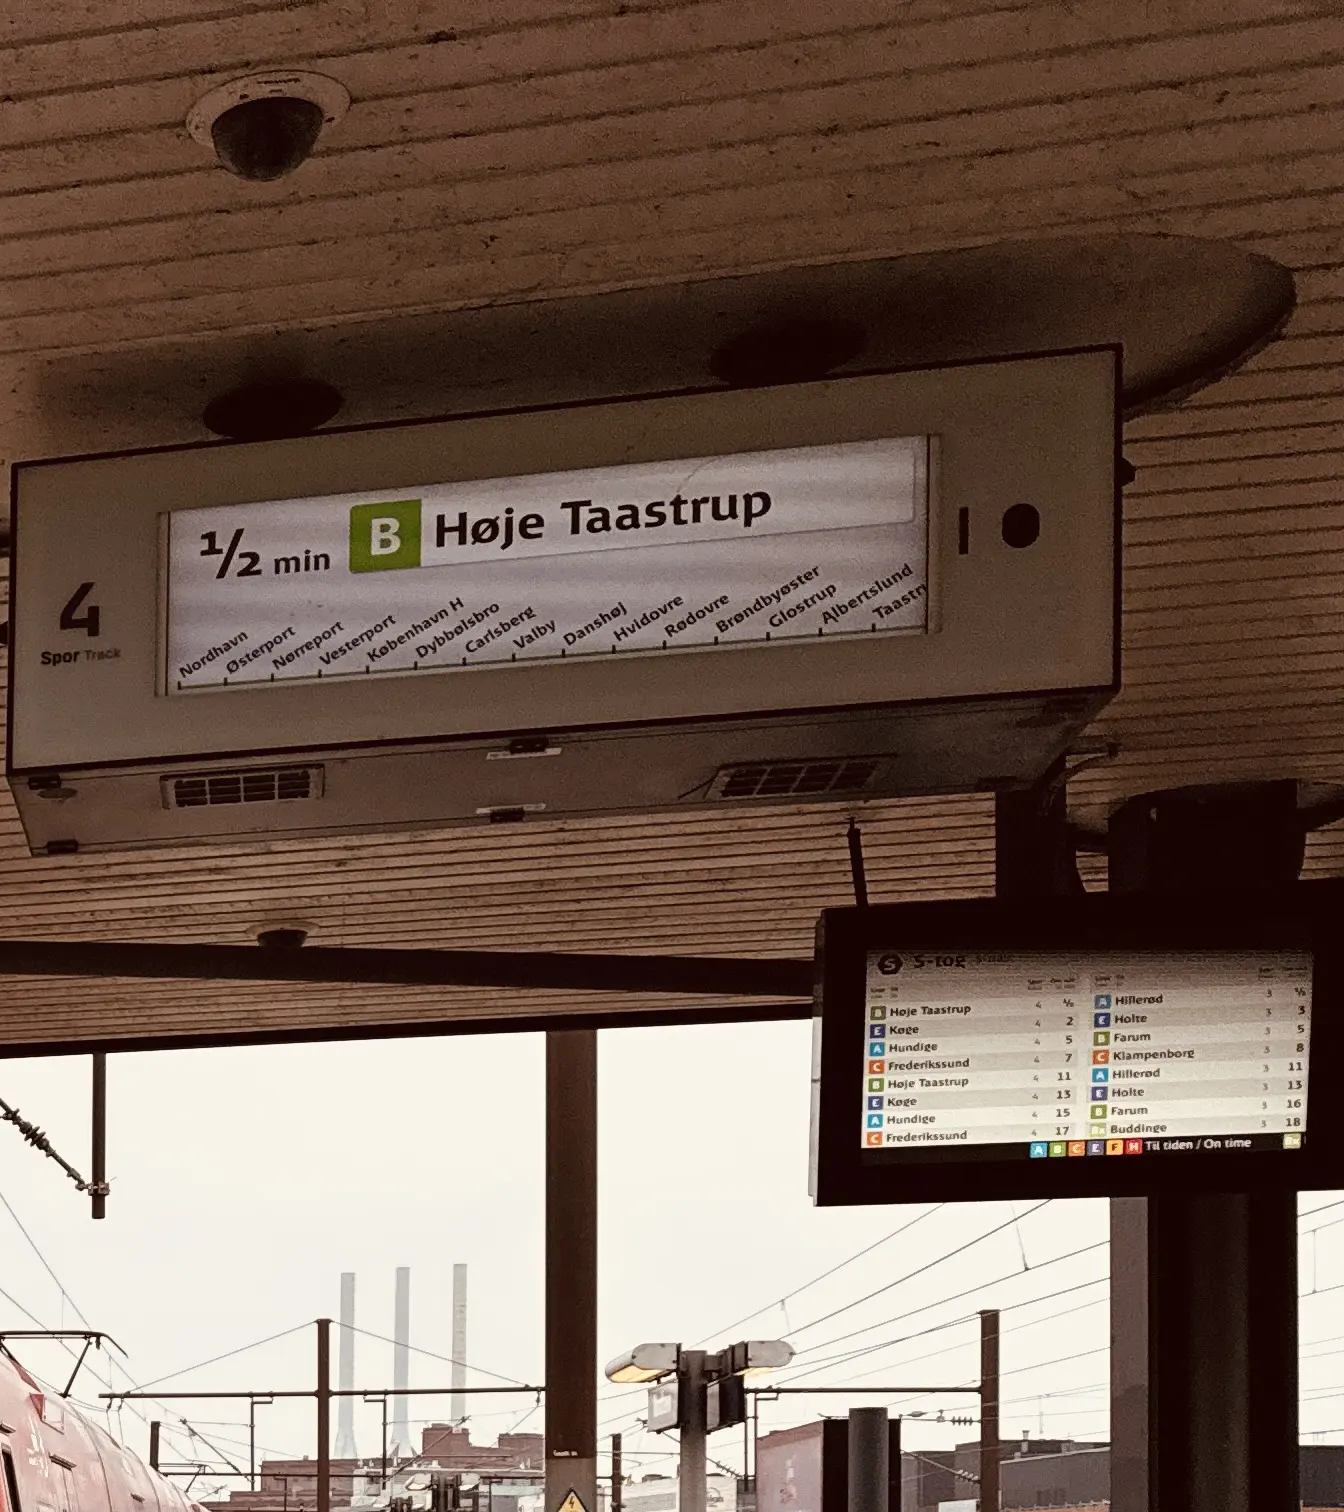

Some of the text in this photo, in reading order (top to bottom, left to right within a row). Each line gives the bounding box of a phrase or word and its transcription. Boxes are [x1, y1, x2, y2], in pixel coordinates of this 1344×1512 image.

[273, 549, 331, 574] min
[370, 517, 401, 556] B
[435, 507, 545, 550] Høje
[560, 490, 772, 537] Taastrup
[715, 565, 820, 633] Brøndbyøster
[821, 563, 914, 625] Albertslund
[59, 581, 100, 637] 4
[769, 584, 837, 628] Glostrup
[563, 601, 628, 646] Danshøj
[613, 596, 684, 642] Hvidovre
[664, 595, 730, 638] Rødovre
[367, 596, 465, 662] København H
[415, 603, 500, 658] Dybbølsbro
[465, 606, 537, 653] Carlsberg
[512, 620, 556, 649] Valby
[271, 621, 345, 670] Nørreport
[319, 615, 397, 665] Vesterport
[40, 648, 121, 666] Spor Track
[178, 631, 249, 678] Nordhavn
[226, 626, 297, 675] Østerport
[1115, 994, 1164, 1006] Hillerød
[890, 1006, 917, 1017] Høje
[921, 1004, 972, 1016] Taastrup
[1114, 1014, 1148, 1024] Holte
[1297, 1005, 1306, 1015] 3
[889, 1025, 919, 1035] Køge
[1065, 1017, 1074, 1026] 2
[1114, 1033, 1151, 1043] Farum
[1297, 1024, 1305, 1034] 5
[889, 1042, 938, 1053] Hundige
[1065, 1035, 1073, 1044] 5
[1113, 1049, 1195, 1062] Klampenborg
[1296, 1043, 1304, 1052] 8
[888, 1058, 970, 1071] Frederikssund
[1065, 1053, 1072, 1063] 7
[1112, 1067, 1161, 1079] Hillerød
[1288, 1062, 1303, 1071] 11
[887, 1079, 915, 1090] Høje
[919, 1077, 970, 1089] Taastrup
[1057, 1071, 1072, 1081] 11
[1112, 1088, 1145, 1098] Holte
[1287, 1080, 1303, 1090] 13
[887, 1097, 917, 1107] Køge
[1056, 1090, 1071, 1099] 13
[1111, 1106, 1148, 1116] Farum
[1286, 1099, 1302, 1108] 16
[887, 1114, 936, 1126] Hundige
[1055, 1108, 1071, 1118] 15
[1111, 1123, 1168, 1134] Buddinge
[1286, 1117, 1301, 1127] 18
[886, 1130, 968, 1143] Frederikssund
[1055, 1126, 1070, 1136] 17
[1144, 1140, 1160, 1151] Til
[1162, 1138, 1193, 1150] tiden
[1203, 1138, 1221, 1149] On
[1224, 1137, 1252, 1148] time
